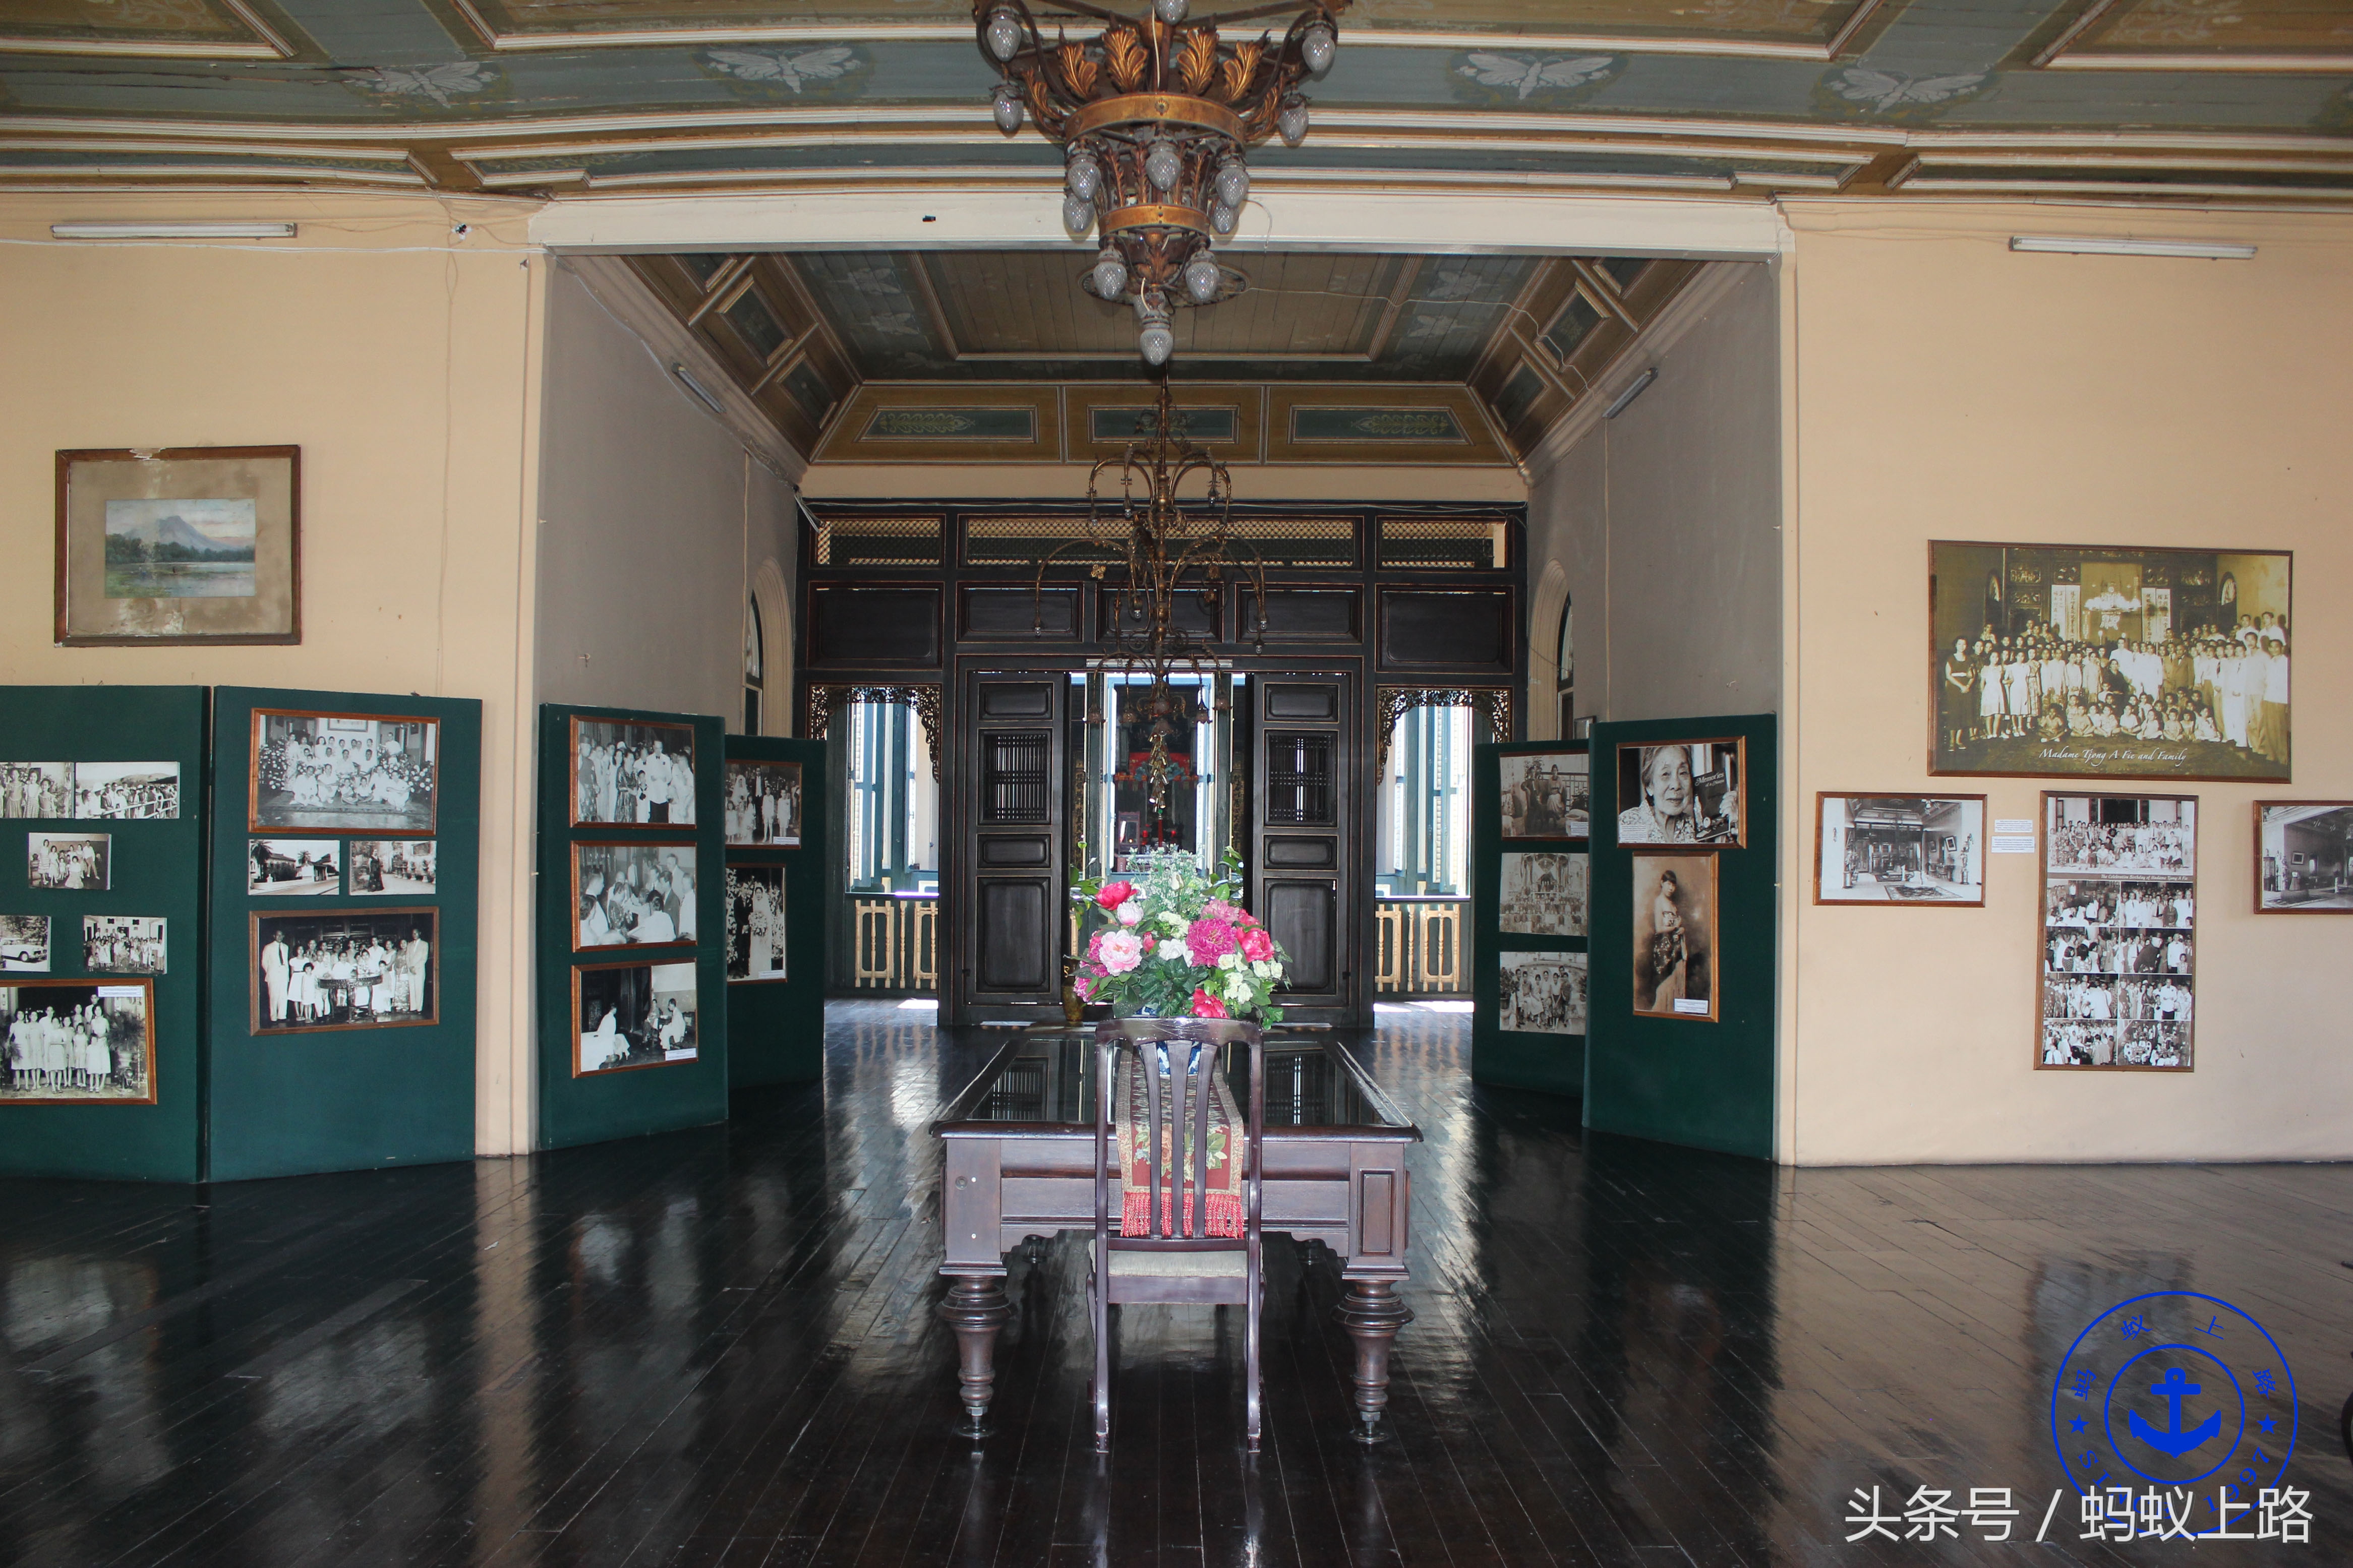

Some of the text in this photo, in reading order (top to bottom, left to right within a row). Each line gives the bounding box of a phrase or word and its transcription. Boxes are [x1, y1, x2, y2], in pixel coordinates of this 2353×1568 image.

[2039, 746, 2188, 767] Madame Tjong A Fie and Family
